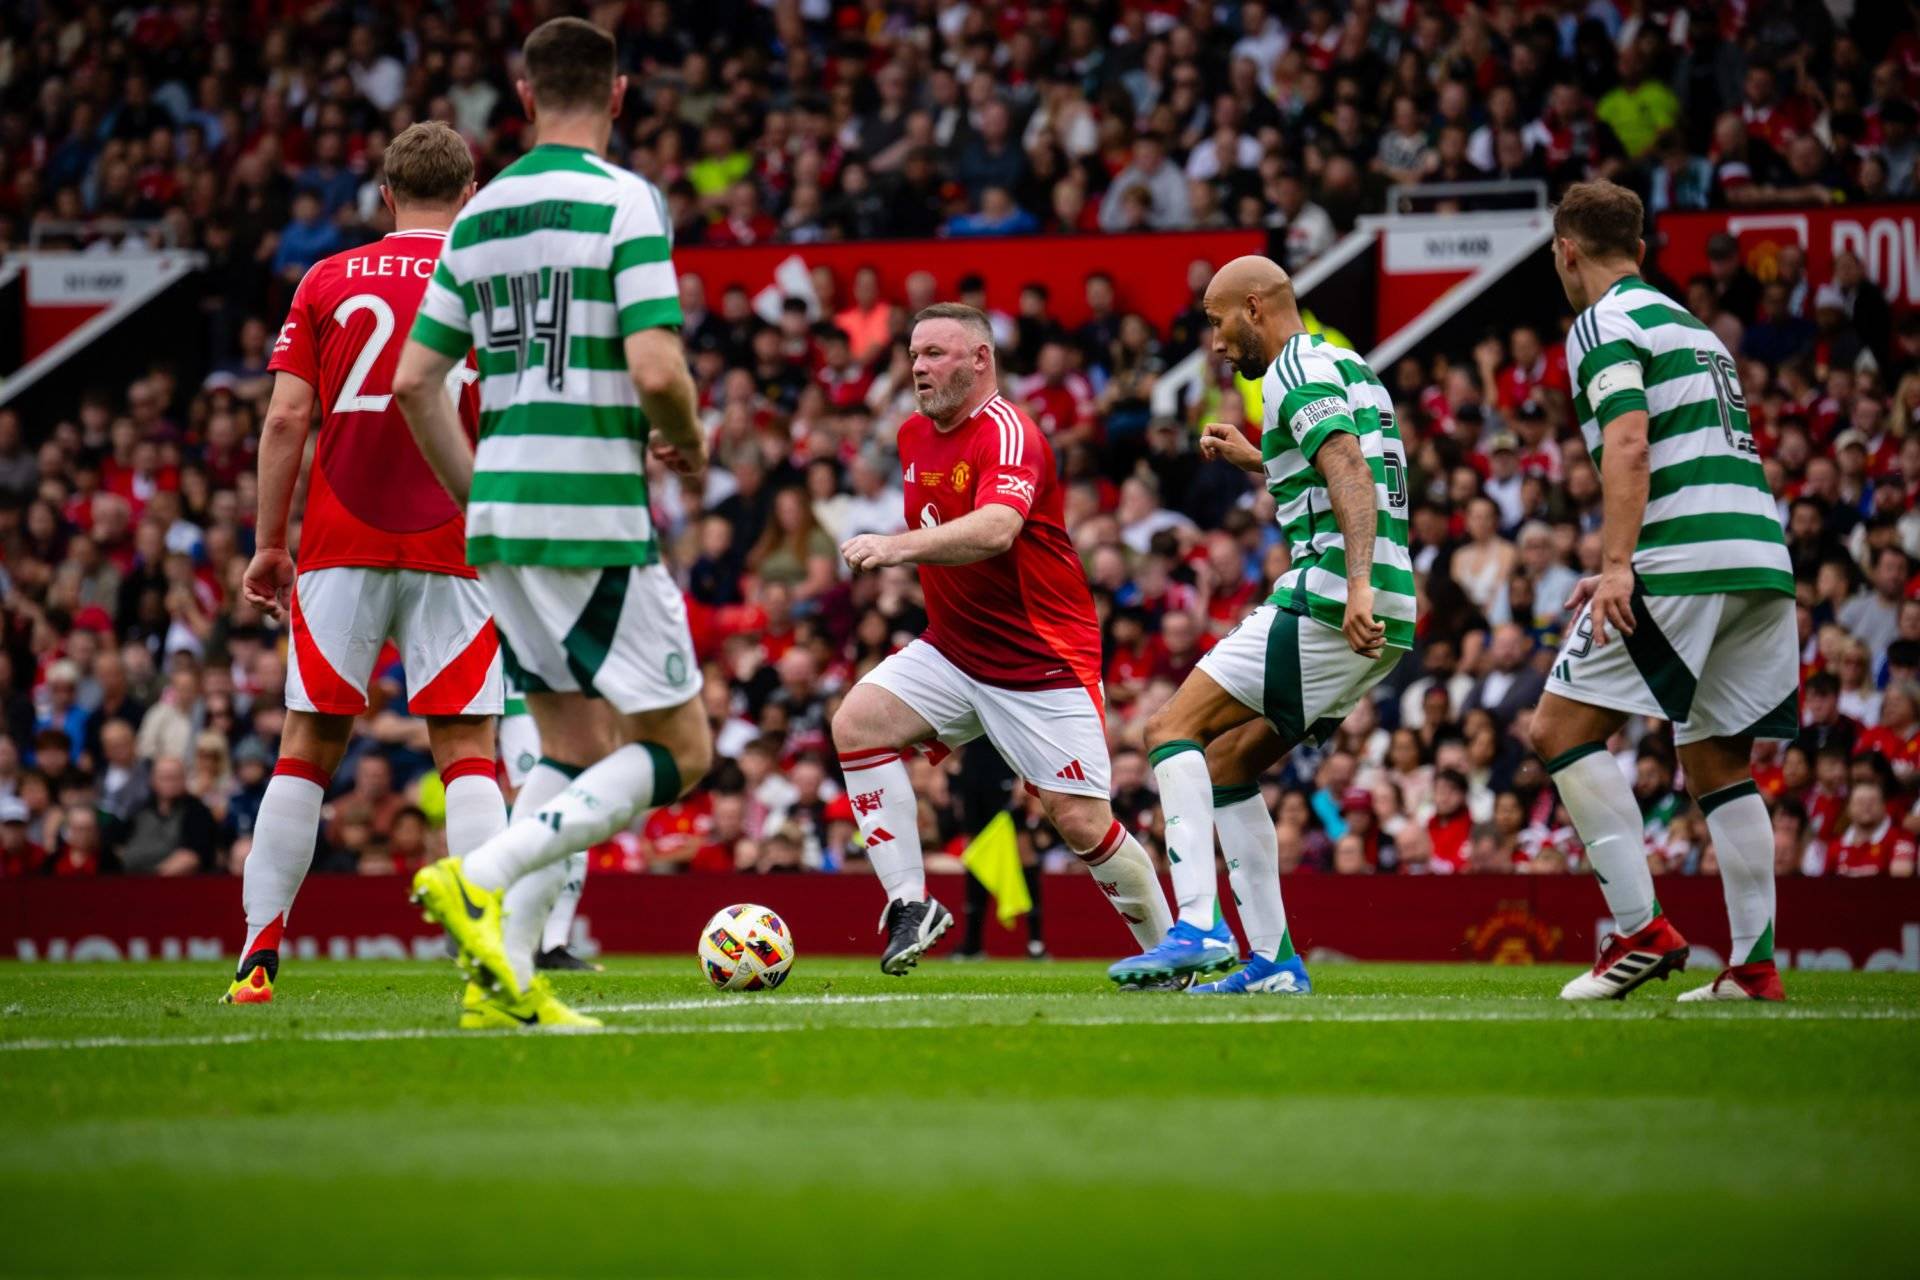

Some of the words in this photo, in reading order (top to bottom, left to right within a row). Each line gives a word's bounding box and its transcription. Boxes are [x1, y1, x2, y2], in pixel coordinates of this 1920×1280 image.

[478, 203, 574, 239] MCMANUS
[474, 266, 574, 393] 44
[1303, 398, 1328, 417] CELTIC
[1328, 397, 1340, 407] FC
[1695, 349, 1758, 456] 19
